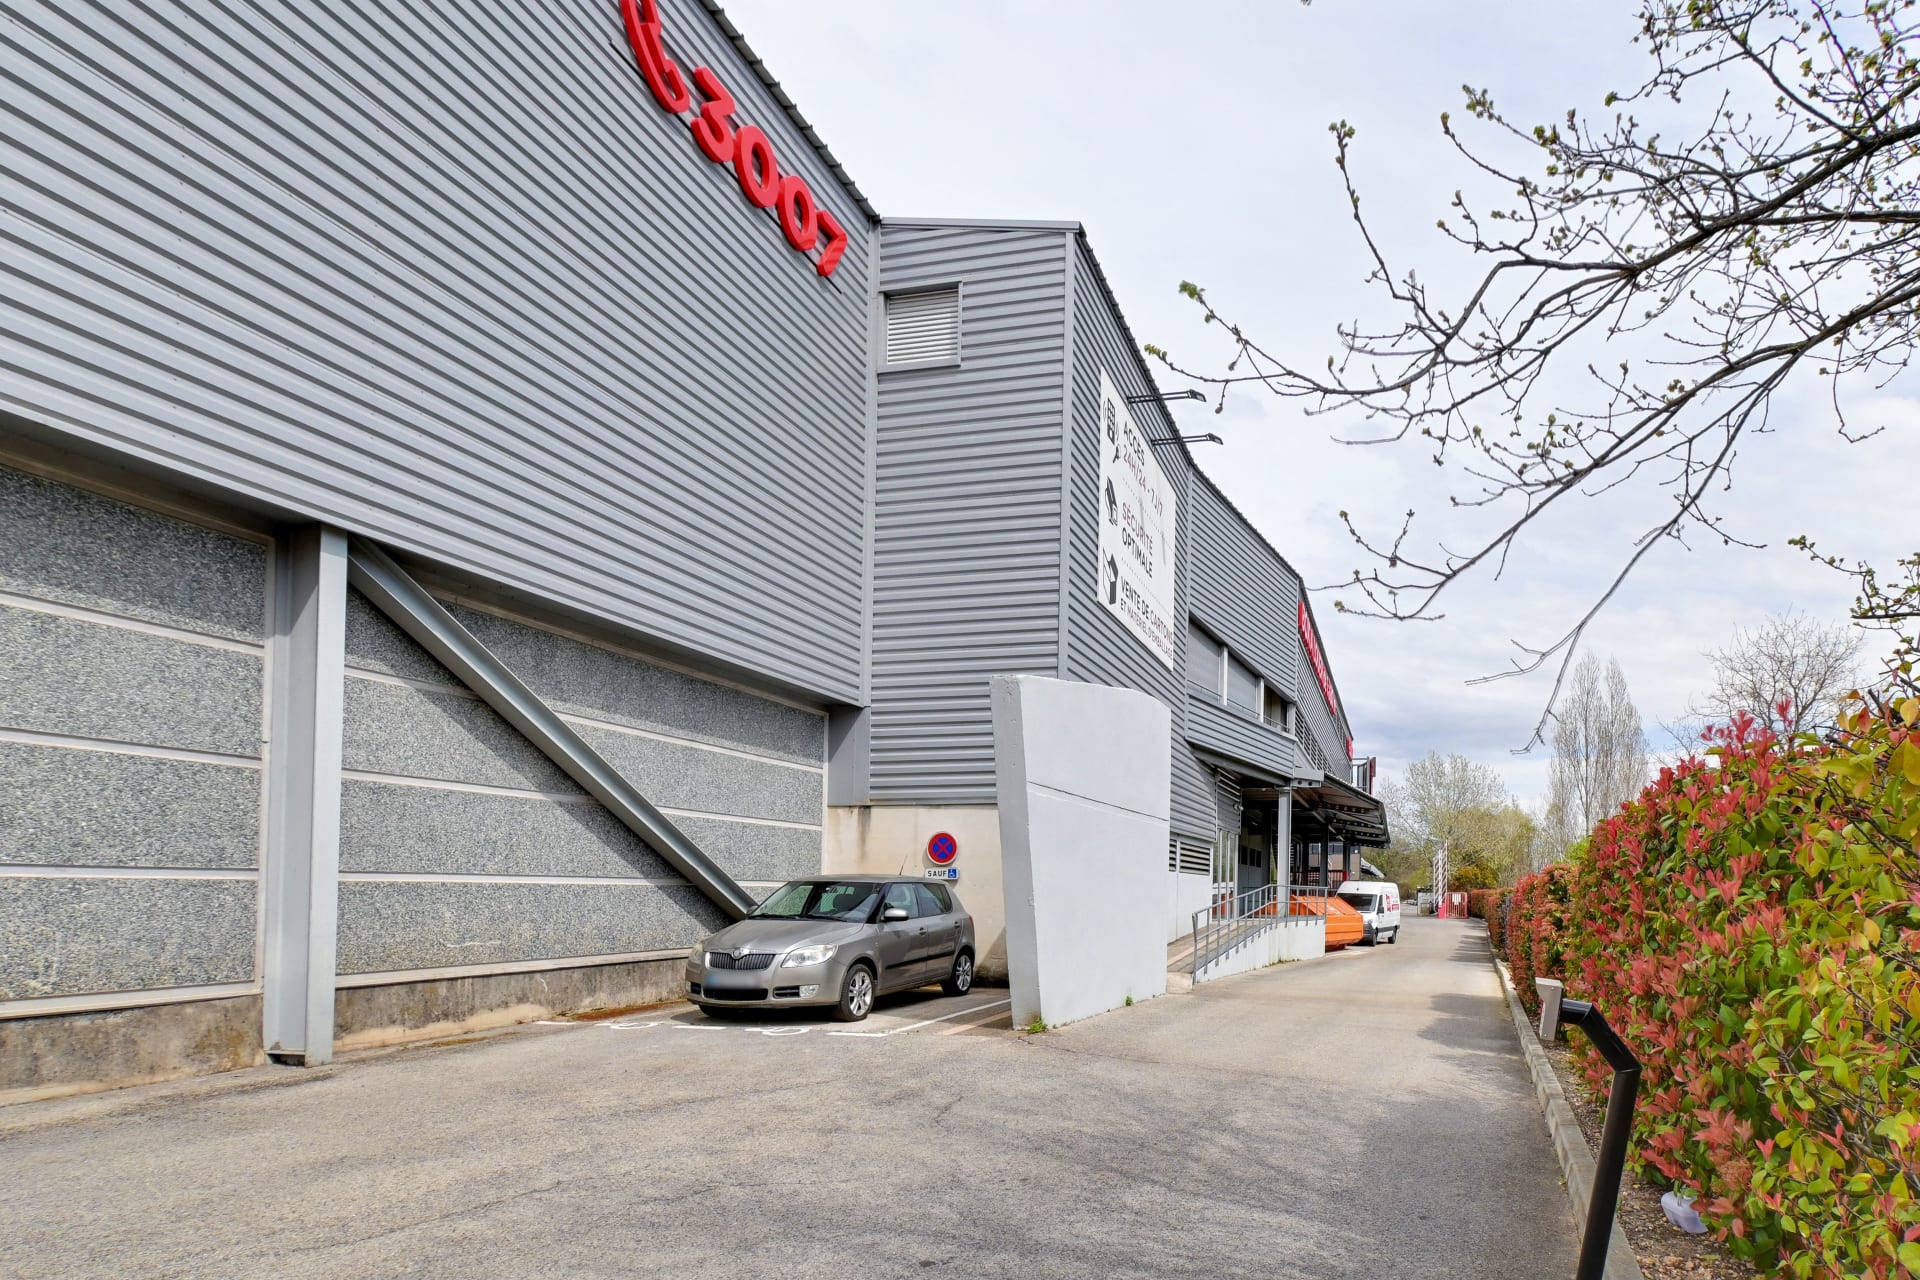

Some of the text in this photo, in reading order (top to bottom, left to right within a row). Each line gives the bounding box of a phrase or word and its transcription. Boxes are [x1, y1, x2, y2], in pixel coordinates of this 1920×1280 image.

[1124, 421, 1145, 466] ACCÈS
[1123, 444, 1146, 492] 24H/24
[1122, 502, 1153, 557] SÉCURITÉ
[1122, 527, 1153, 579] OPTIMALE
[1120, 597, 1127, 613] ET
[1121, 576, 1141, 611] VENTE
[1141, 600, 1150, 620] DE
